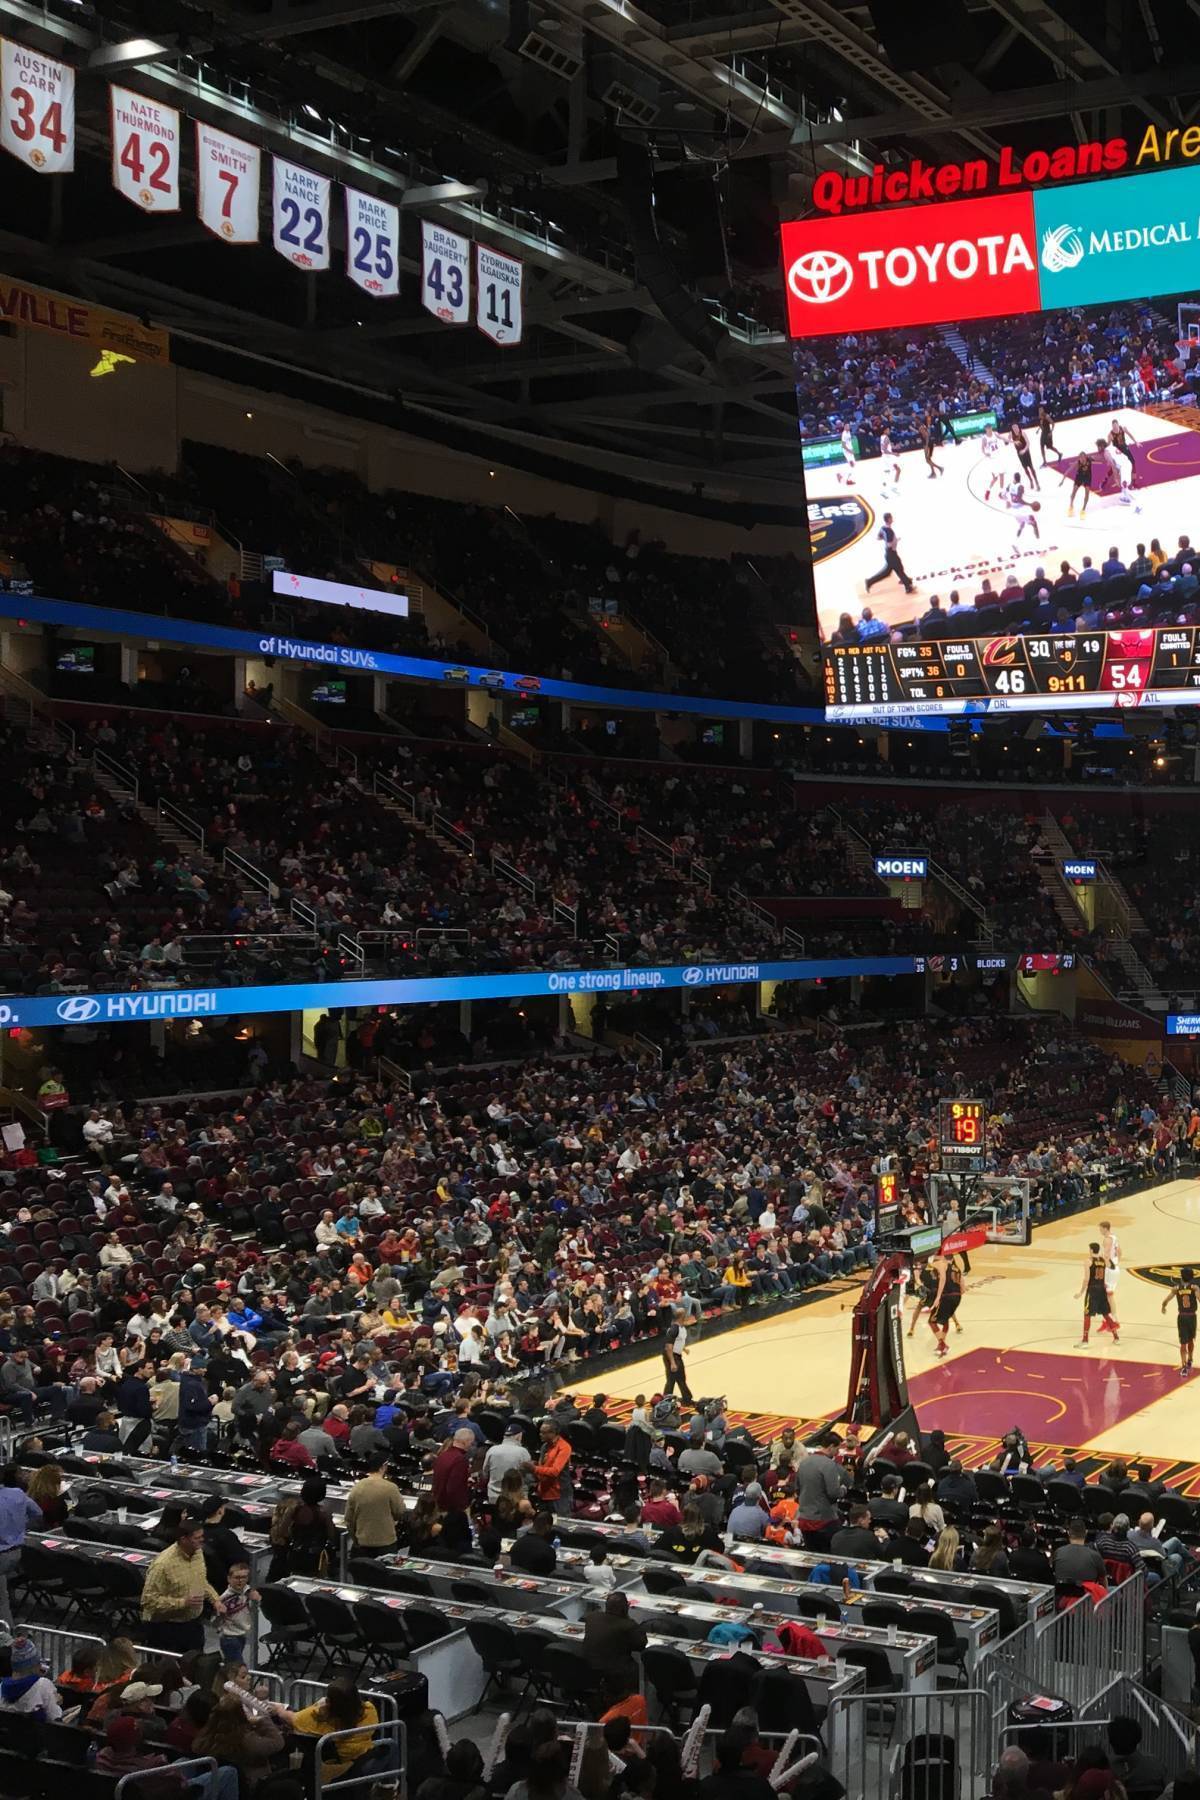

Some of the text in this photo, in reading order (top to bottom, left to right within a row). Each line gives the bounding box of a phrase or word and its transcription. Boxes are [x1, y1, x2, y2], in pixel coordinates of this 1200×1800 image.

[14, 52, 61, 82] AUSTIN
[20, 71, 55, 95] CARR
[10, 86, 66, 154] 34
[130, 100, 160, 122] NATE
[116, 109, 174, 141] THURMOND
[120, 133, 171, 193] 42
[210, 151, 247, 173] SMITH
[285, 168, 319, 191] LARRY
[812, 159, 987, 214] Quicken
[999, 137, 1127, 186] Loans
[219, 170, 238, 218] 7
[285, 181, 320, 205] NANCE
[358, 198, 387, 218] MARK
[280, 198, 323, 254] 22
[358, 212, 387, 232] PRICE
[433, 230, 458, 249] BRAD
[1089, 222, 1191, 255] MEDICAL
[353, 227, 393, 279] 25
[859, 232, 1034, 290] TOYOTA
[480, 253, 519, 276] ZYDRUNAS
[427, 258, 463, 307] 43
[480, 264, 520, 287] ILGAUSKAS
[486, 283, 513, 328] 11
[1083, 640, 1099, 653] 19
[1163, 633, 1187, 642] FOULS
[259, 638, 378, 668] of Hyundai SUVs.
[863, 646, 874, 654] AST
[897, 646, 932, 658] FG% 35
[946, 645, 969, 653] FOULS
[1029, 640, 1050, 657] 3Q
[1060, 651, 1072, 661] -8
[1172, 653, 1177, 666] 1
[900, 665, 940, 678] 3PT% 36
[957, 664, 965, 677] 0
[1111, 664, 1141, 689] 54
[995, 669, 1025, 693] 46
[1048, 675, 1085, 691] 9:11
[909, 686, 944, 698] TOL 6
[1145, 693, 1160, 703] ATL
[917, 703, 943, 712] SCORES
[994, 699, 1010, 709] ORL
[877, 860, 924, 875] MOEN
[1065, 864, 1094, 876] MOEN
[951, 958, 957, 971] 3
[976, 959, 1006, 968] BLOCKS
[1025, 957, 1033, 969] 2
[548, 969, 665, 990] One strong lineup.
[705, 965, 760, 982] HYUNDAI
[106, 992, 216, 1018] HYUNDAI
[952, 1104, 979, 1119] 9:11
[956, 1118, 976, 1143] 19
[953, 1146, 982, 1155] TISSOT
